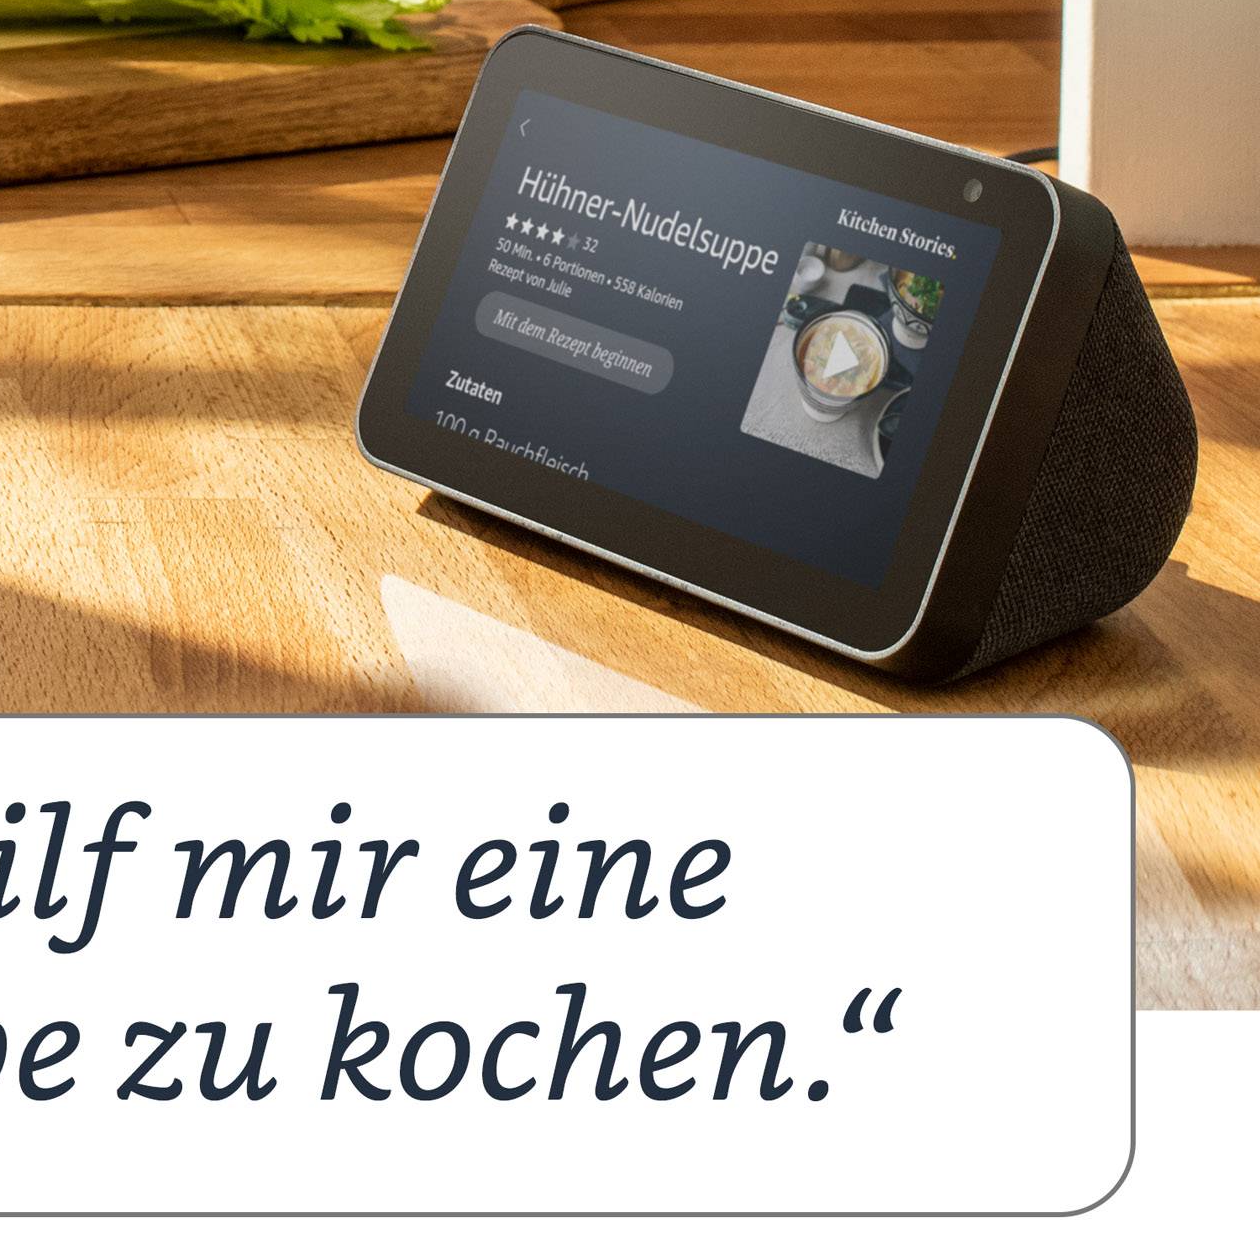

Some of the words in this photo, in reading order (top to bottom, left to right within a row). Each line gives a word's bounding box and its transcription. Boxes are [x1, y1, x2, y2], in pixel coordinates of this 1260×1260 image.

[518, 166, 778, 275] Hühner-Nudelsuppe
[583, 237, 598, 253] 32
[838, 209, 897, 240] Kitchen
[899, 228, 956, 259] Stories.
[488, 258, 524, 281] Rezept
[526, 273, 545, 288] von
[546, 279, 572, 297] Julie
[496, 237, 511, 253] 50
[511, 243, 532, 261] Min.
[543, 253, 552, 266] 6
[552, 256, 605, 285] Portionen
[613, 276, 636, 294] 558
[636, 284, 683, 310] Kalorien
[493, 309, 518, 330] Mit
[518, 318, 546, 340] dem
[546, 328, 591, 356] Rezept
[591, 342, 652, 377] beginnen
[446, 370, 502, 405] Zutaten
